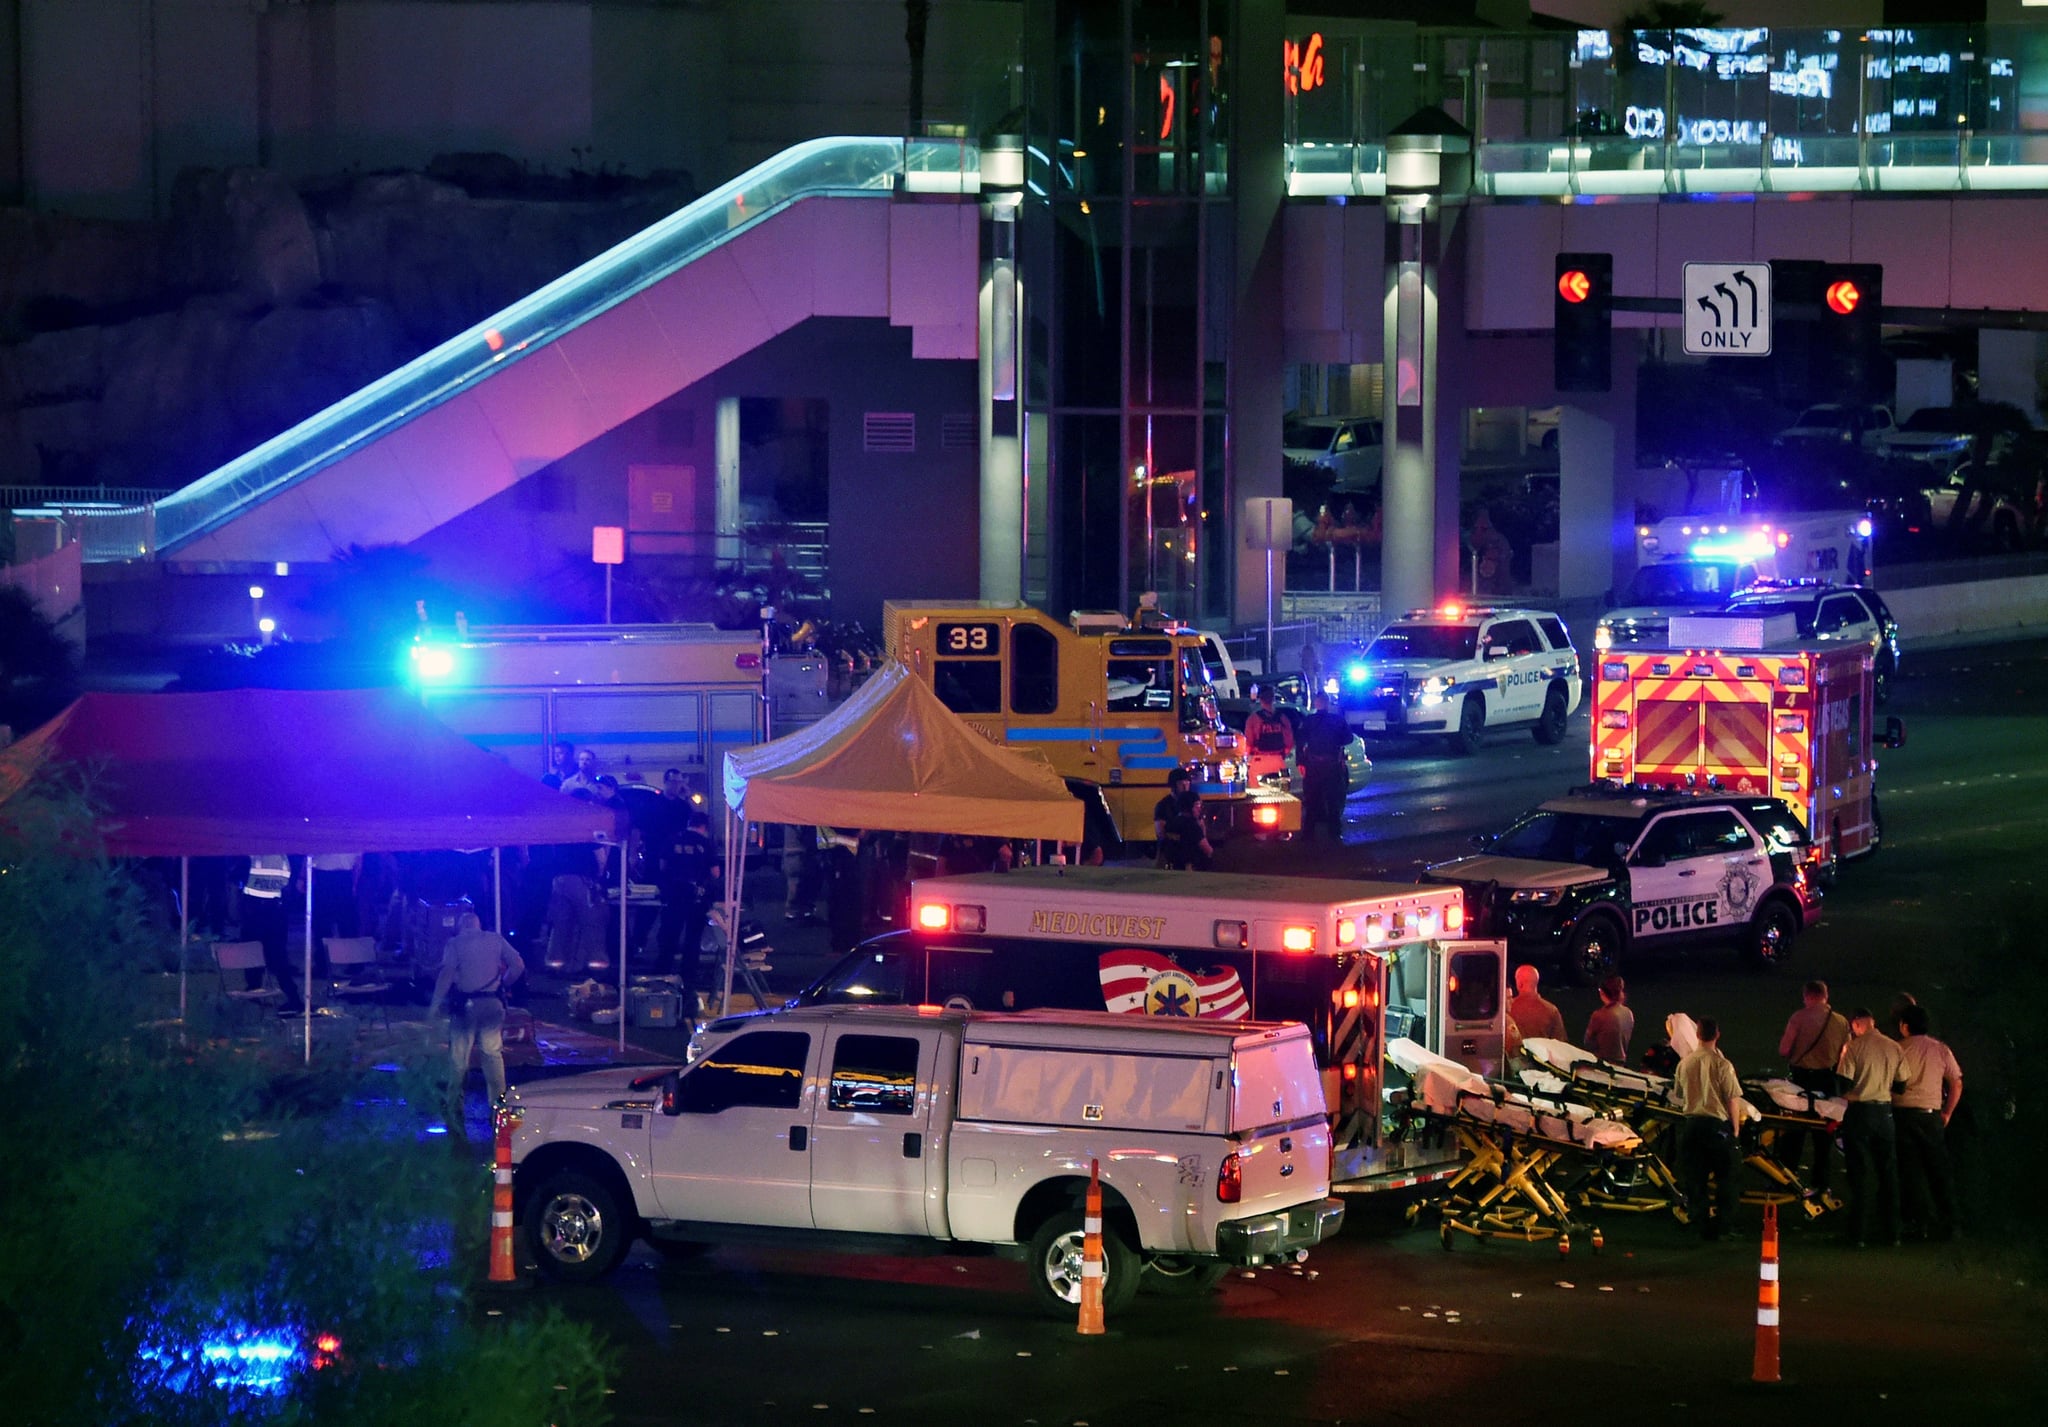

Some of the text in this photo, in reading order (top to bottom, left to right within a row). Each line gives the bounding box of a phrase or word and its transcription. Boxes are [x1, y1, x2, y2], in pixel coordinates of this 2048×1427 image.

[1701, 331, 1752, 348] ONLY
[950, 627, 987, 650] 33
[1507, 671, 1539, 687] POLICE
[1785, 692, 1797, 708] 4
[1030, 910, 1167, 940] MEDICWEST
[1635, 901, 1718, 933] POLICE
